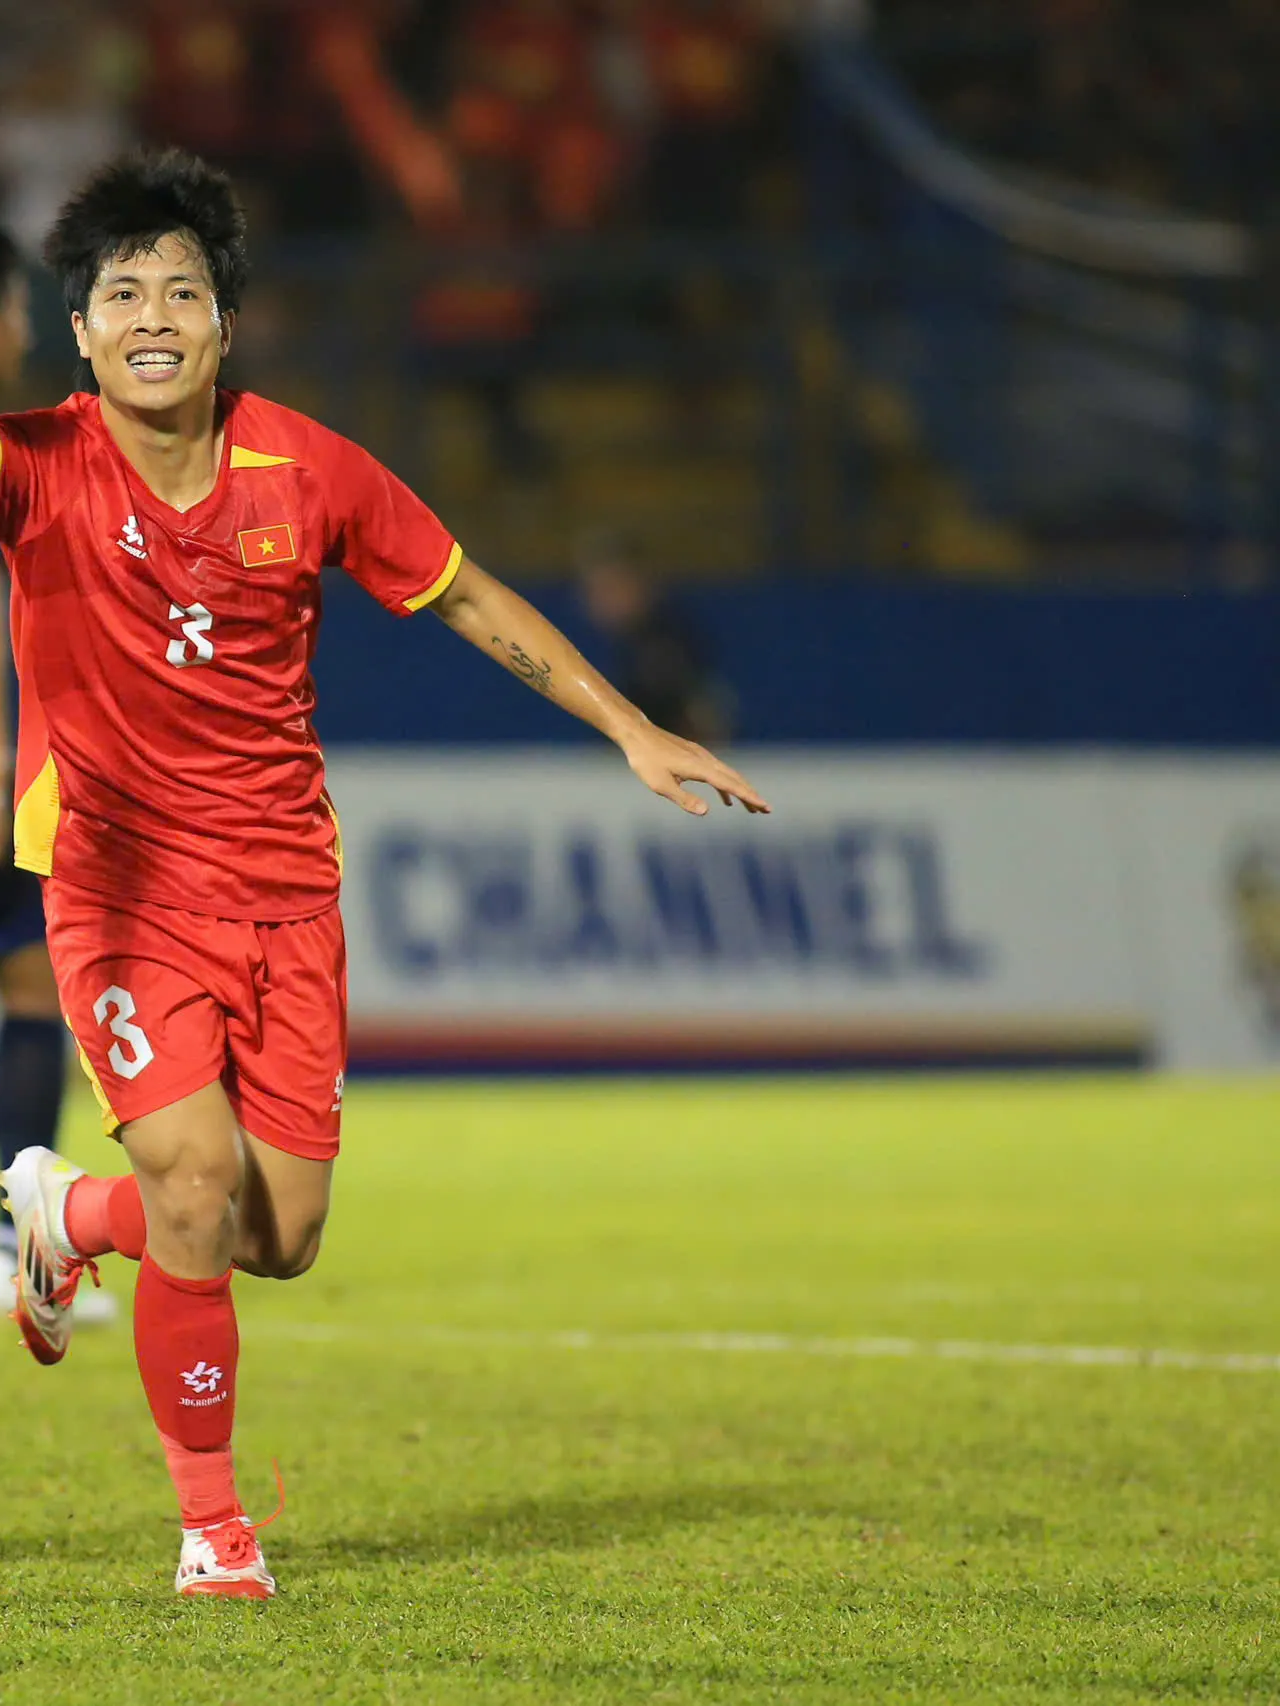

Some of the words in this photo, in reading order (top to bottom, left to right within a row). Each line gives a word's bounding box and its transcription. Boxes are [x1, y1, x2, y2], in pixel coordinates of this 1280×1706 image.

[165, 602, 214, 669] 3
[366, 816, 994, 981] CHANNEL
[92, 984, 155, 1080] 3
